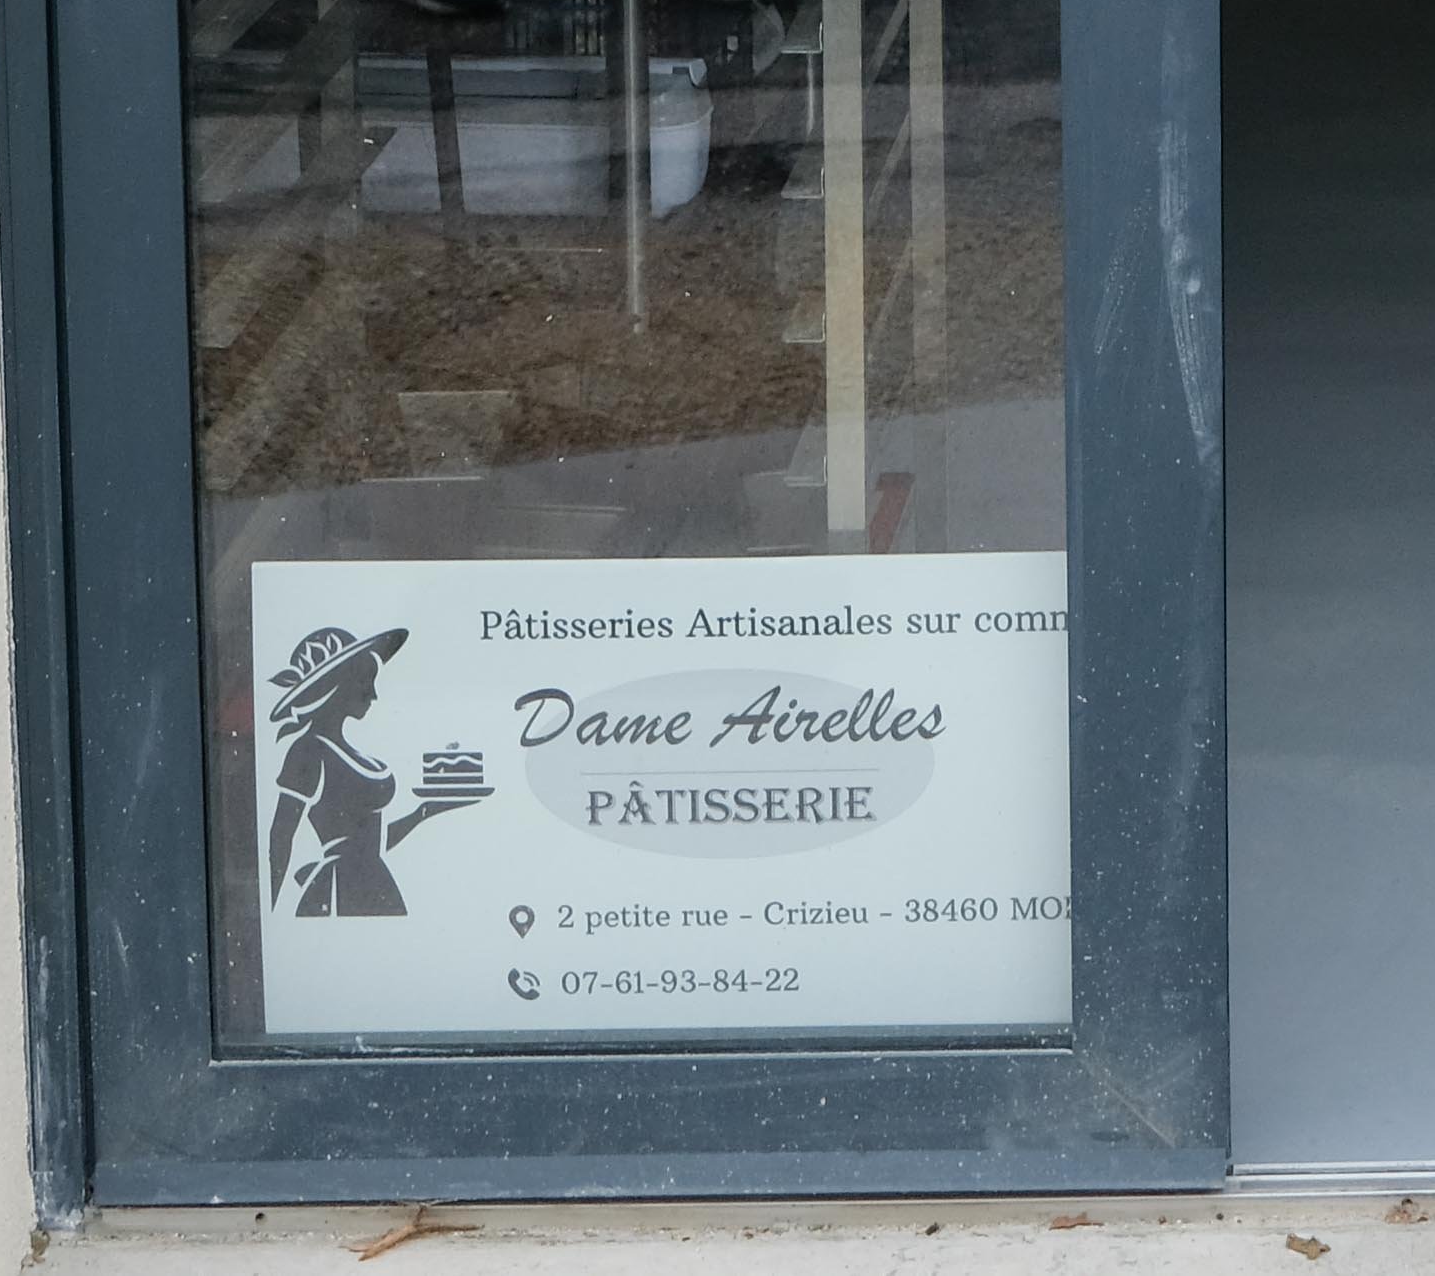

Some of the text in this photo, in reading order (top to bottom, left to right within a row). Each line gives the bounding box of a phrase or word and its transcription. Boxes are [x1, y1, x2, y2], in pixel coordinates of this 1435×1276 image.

[479, 608, 674, 641] Pâtisseries
[685, 604, 893, 638] Artisanales
[906, 611, 962, 635] sur
[513, 684, 947, 748] Dame Airelles
[585, 780, 875, 826] PÂTISSERIE
[557, 904, 575, 929] 2
[584, 902, 671, 935] petite
[681, 909, 729, 927] rue
[763, 899, 870, 926] Crizieu
[904, 896, 999, 923] 38460
[560, 966, 801, 996] 07-61-93-84-22
